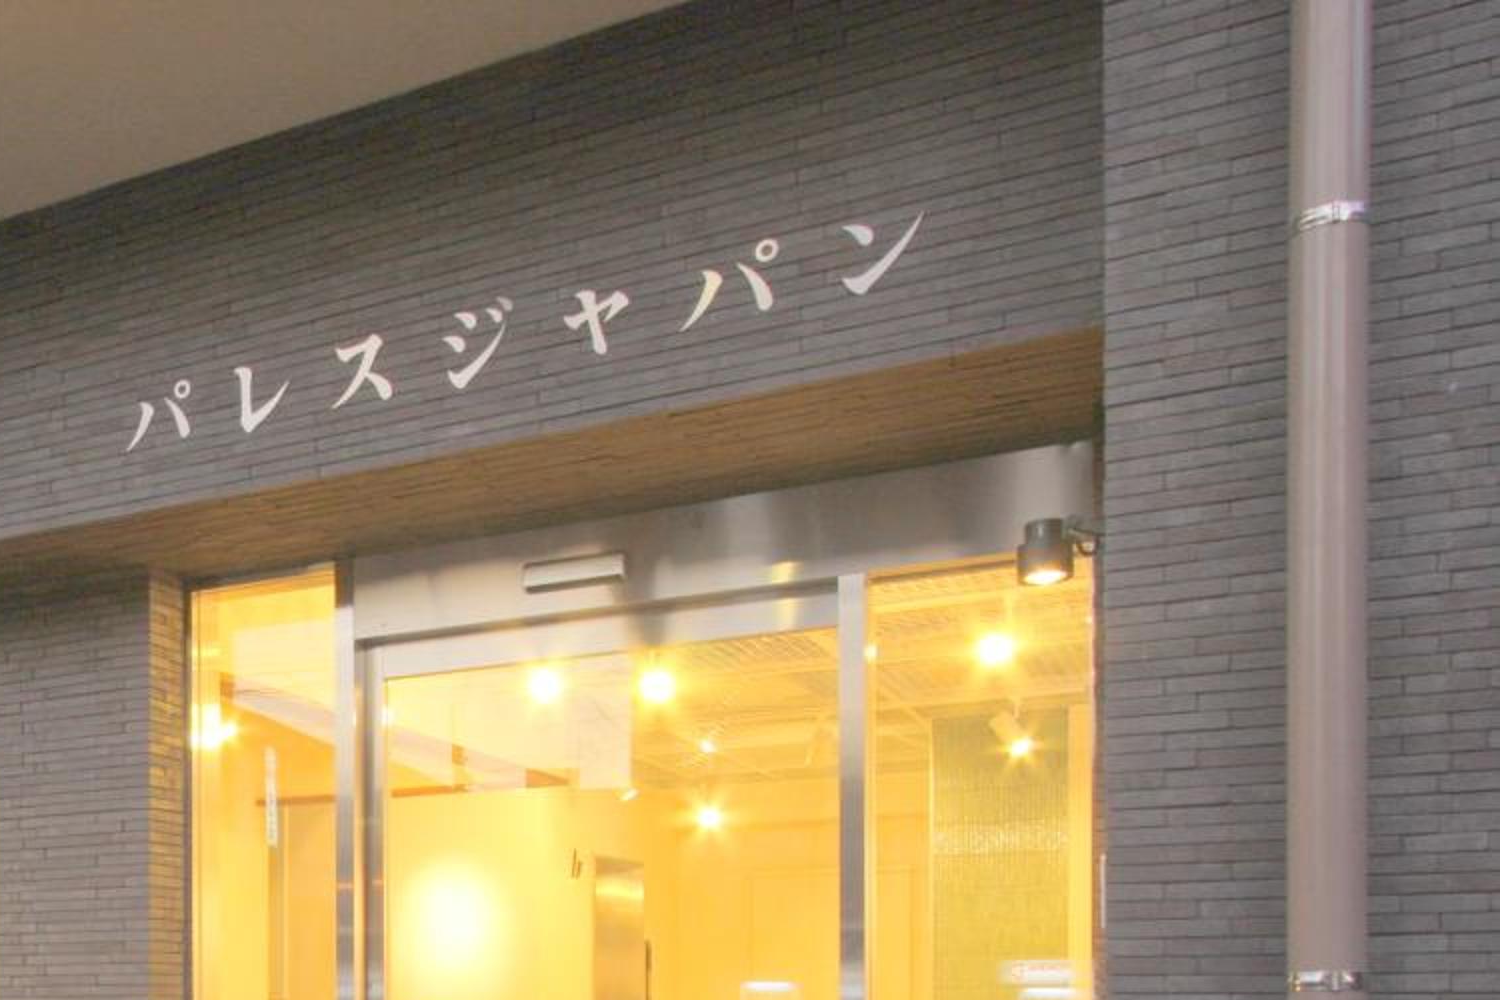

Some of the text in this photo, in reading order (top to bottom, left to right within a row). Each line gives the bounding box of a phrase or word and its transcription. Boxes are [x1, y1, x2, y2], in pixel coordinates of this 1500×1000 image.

[126, 211, 922, 451] パレスジャパン
